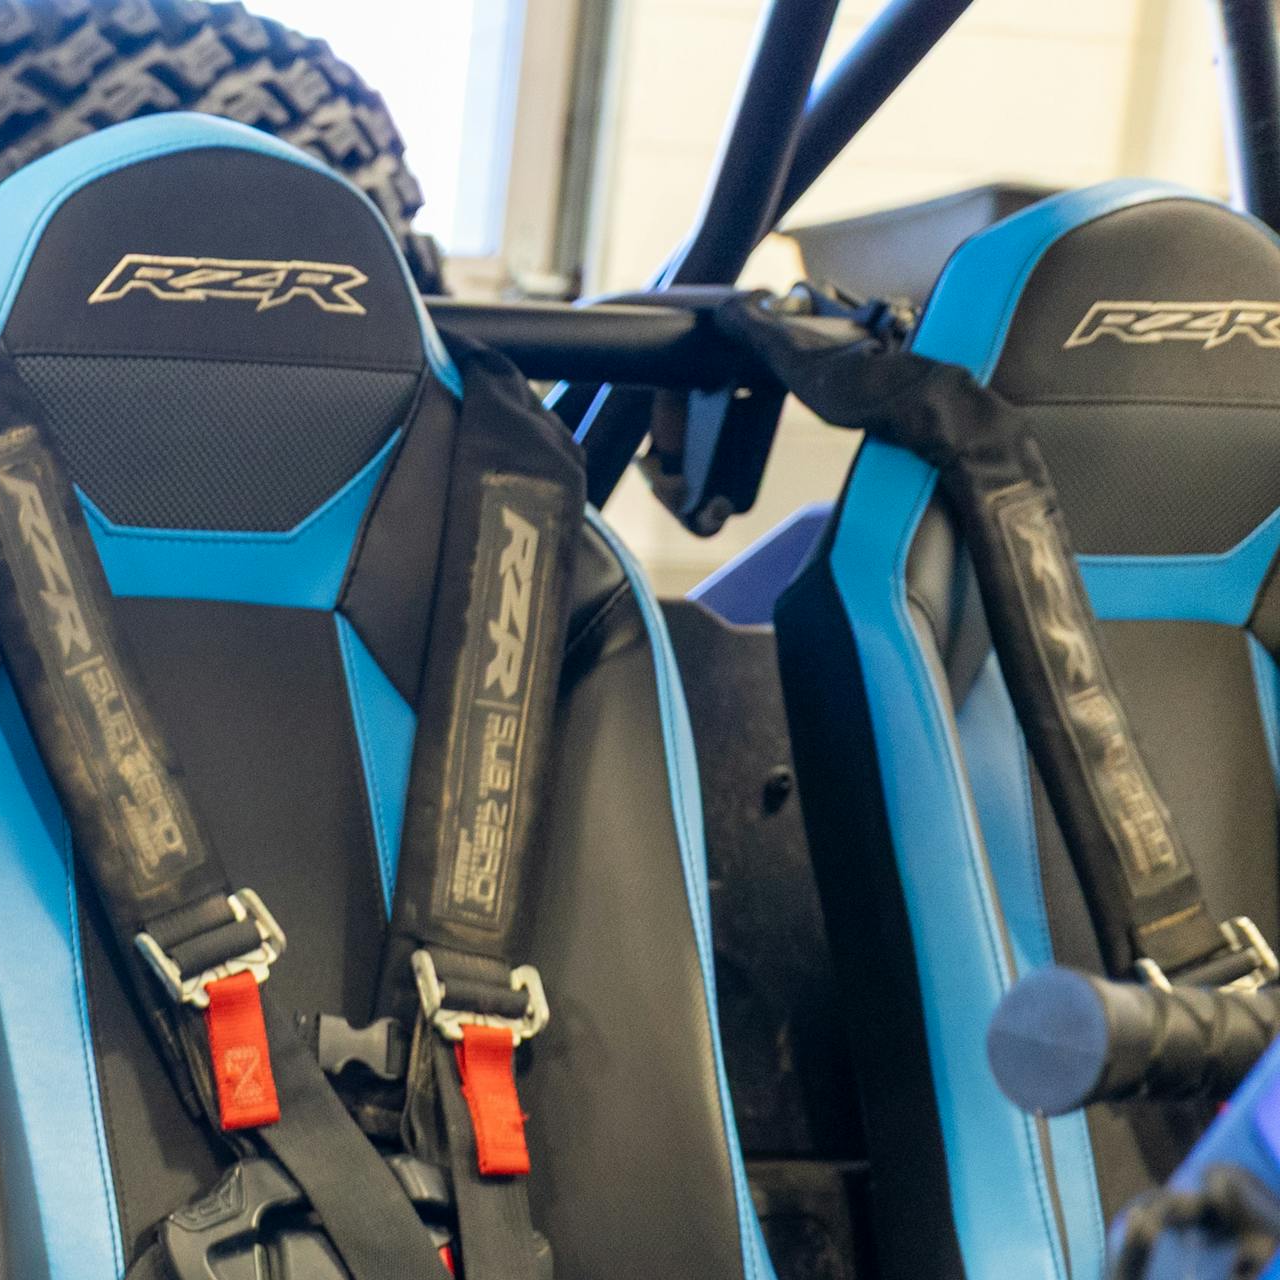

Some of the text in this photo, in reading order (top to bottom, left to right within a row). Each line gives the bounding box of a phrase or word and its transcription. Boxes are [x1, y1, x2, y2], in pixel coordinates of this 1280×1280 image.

[87, 254, 368, 316] RZR
[484, 506, 539, 699] RZR
[487, 712, 518, 793] SUB
[474, 800, 509, 903] ZERO
